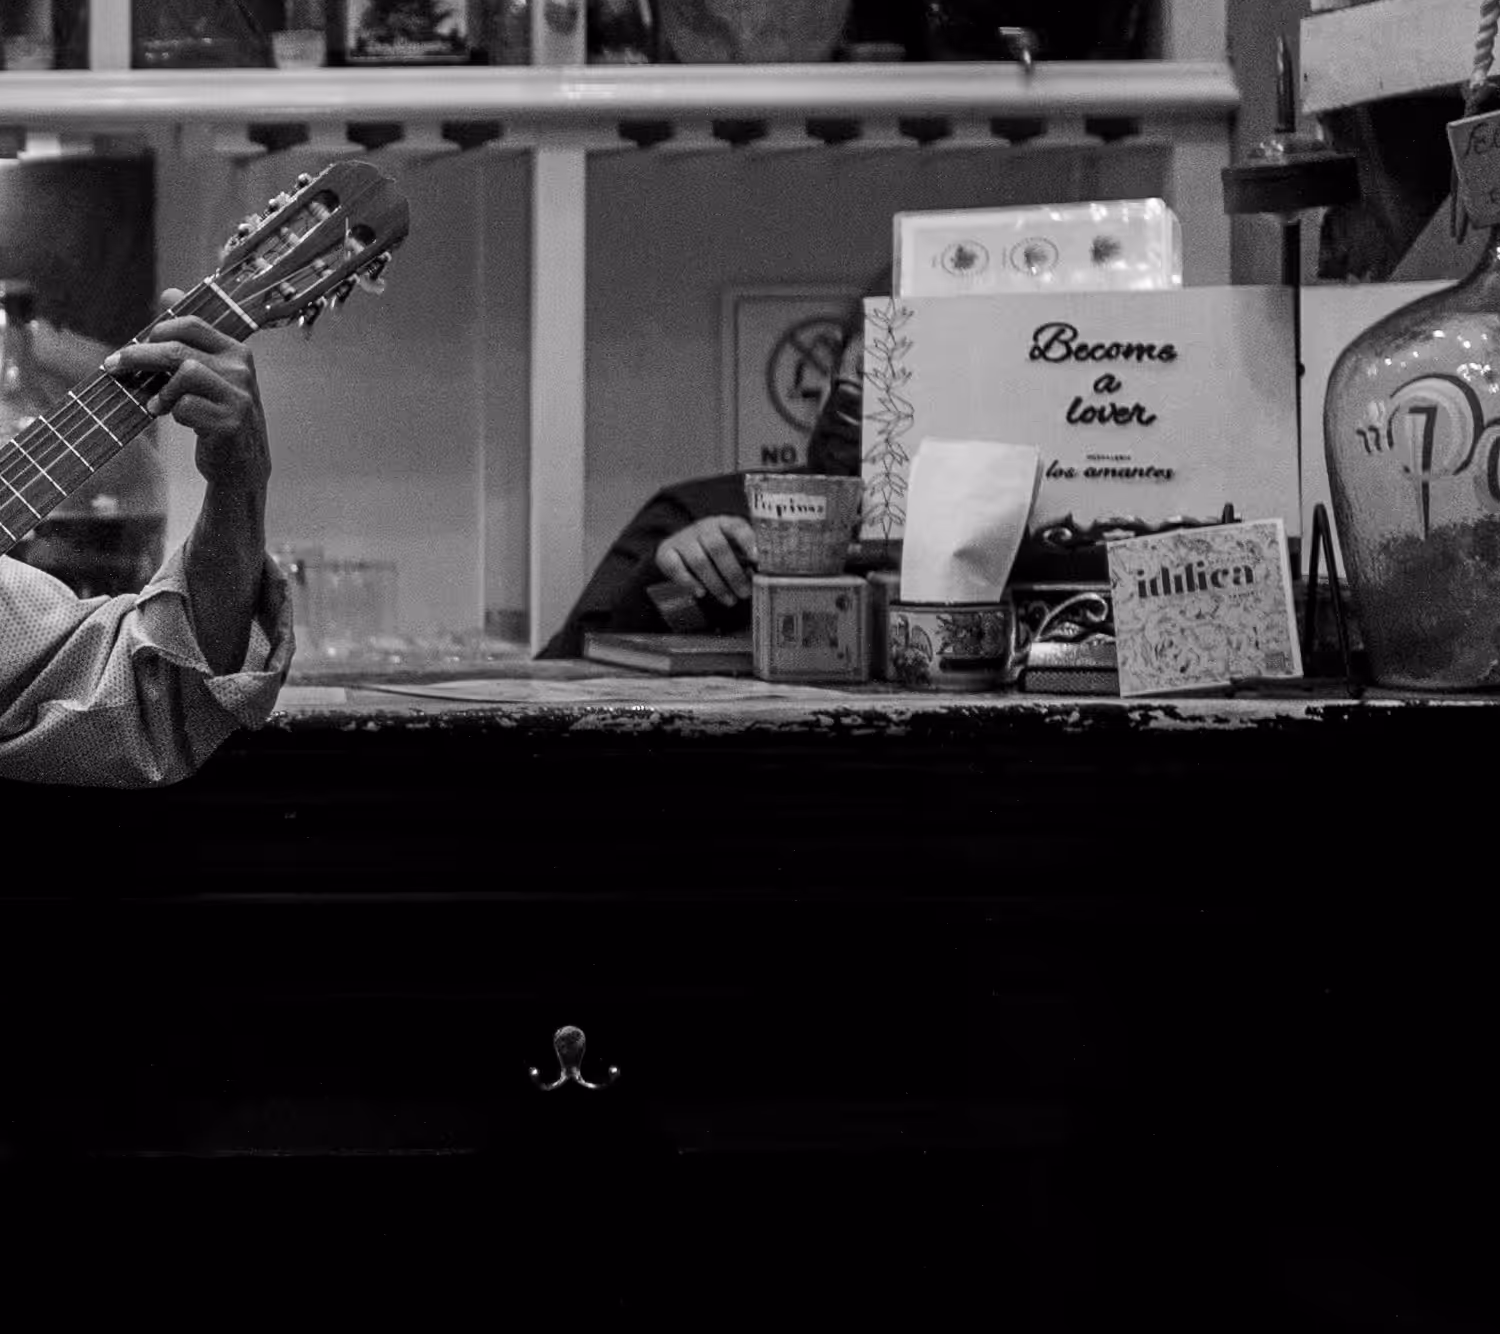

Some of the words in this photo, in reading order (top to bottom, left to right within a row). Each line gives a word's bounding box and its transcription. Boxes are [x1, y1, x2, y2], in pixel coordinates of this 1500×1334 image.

[1029, 321, 1178, 363] Become
[1093, 372, 1122, 394] a
[1066, 395, 1157, 426] lover
[761, 445, 797, 465] NO
[1046, 459, 1075, 479] los
[1083, 463, 1175, 480] amantes
